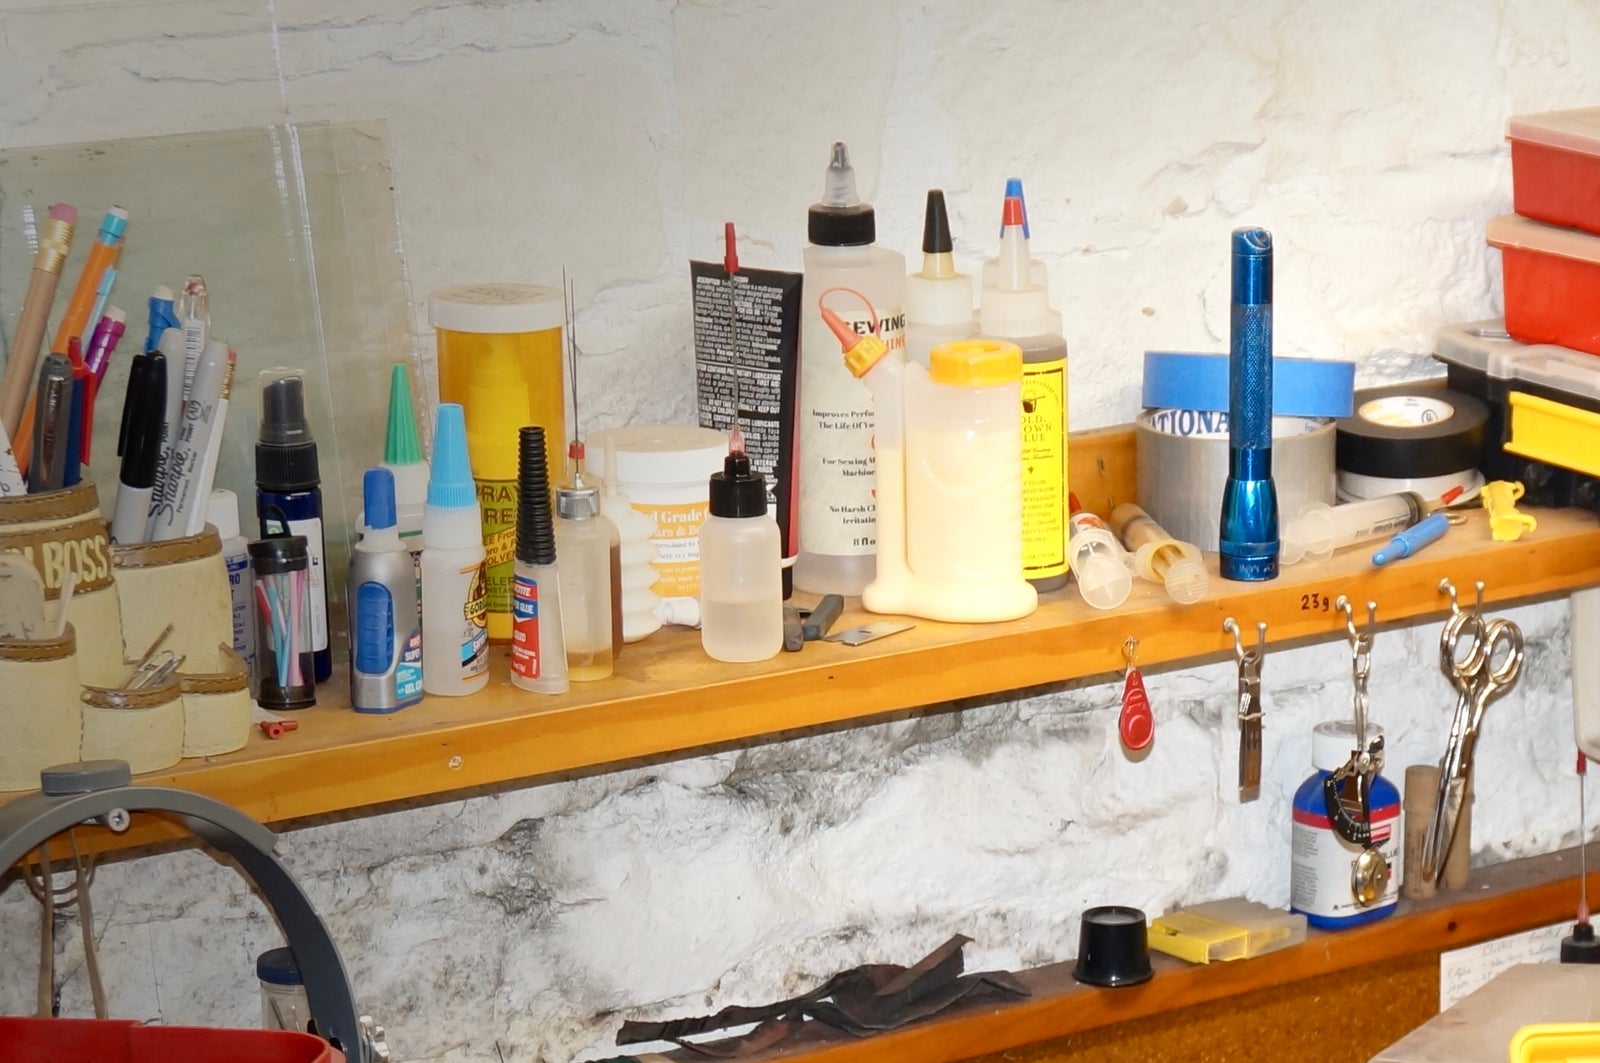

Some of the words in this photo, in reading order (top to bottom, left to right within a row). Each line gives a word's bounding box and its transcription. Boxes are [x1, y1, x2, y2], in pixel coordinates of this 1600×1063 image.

[661, 509, 702, 524] Grade
[676, 526, 685, 537] &
[42, 534, 108, 589] BOSS
